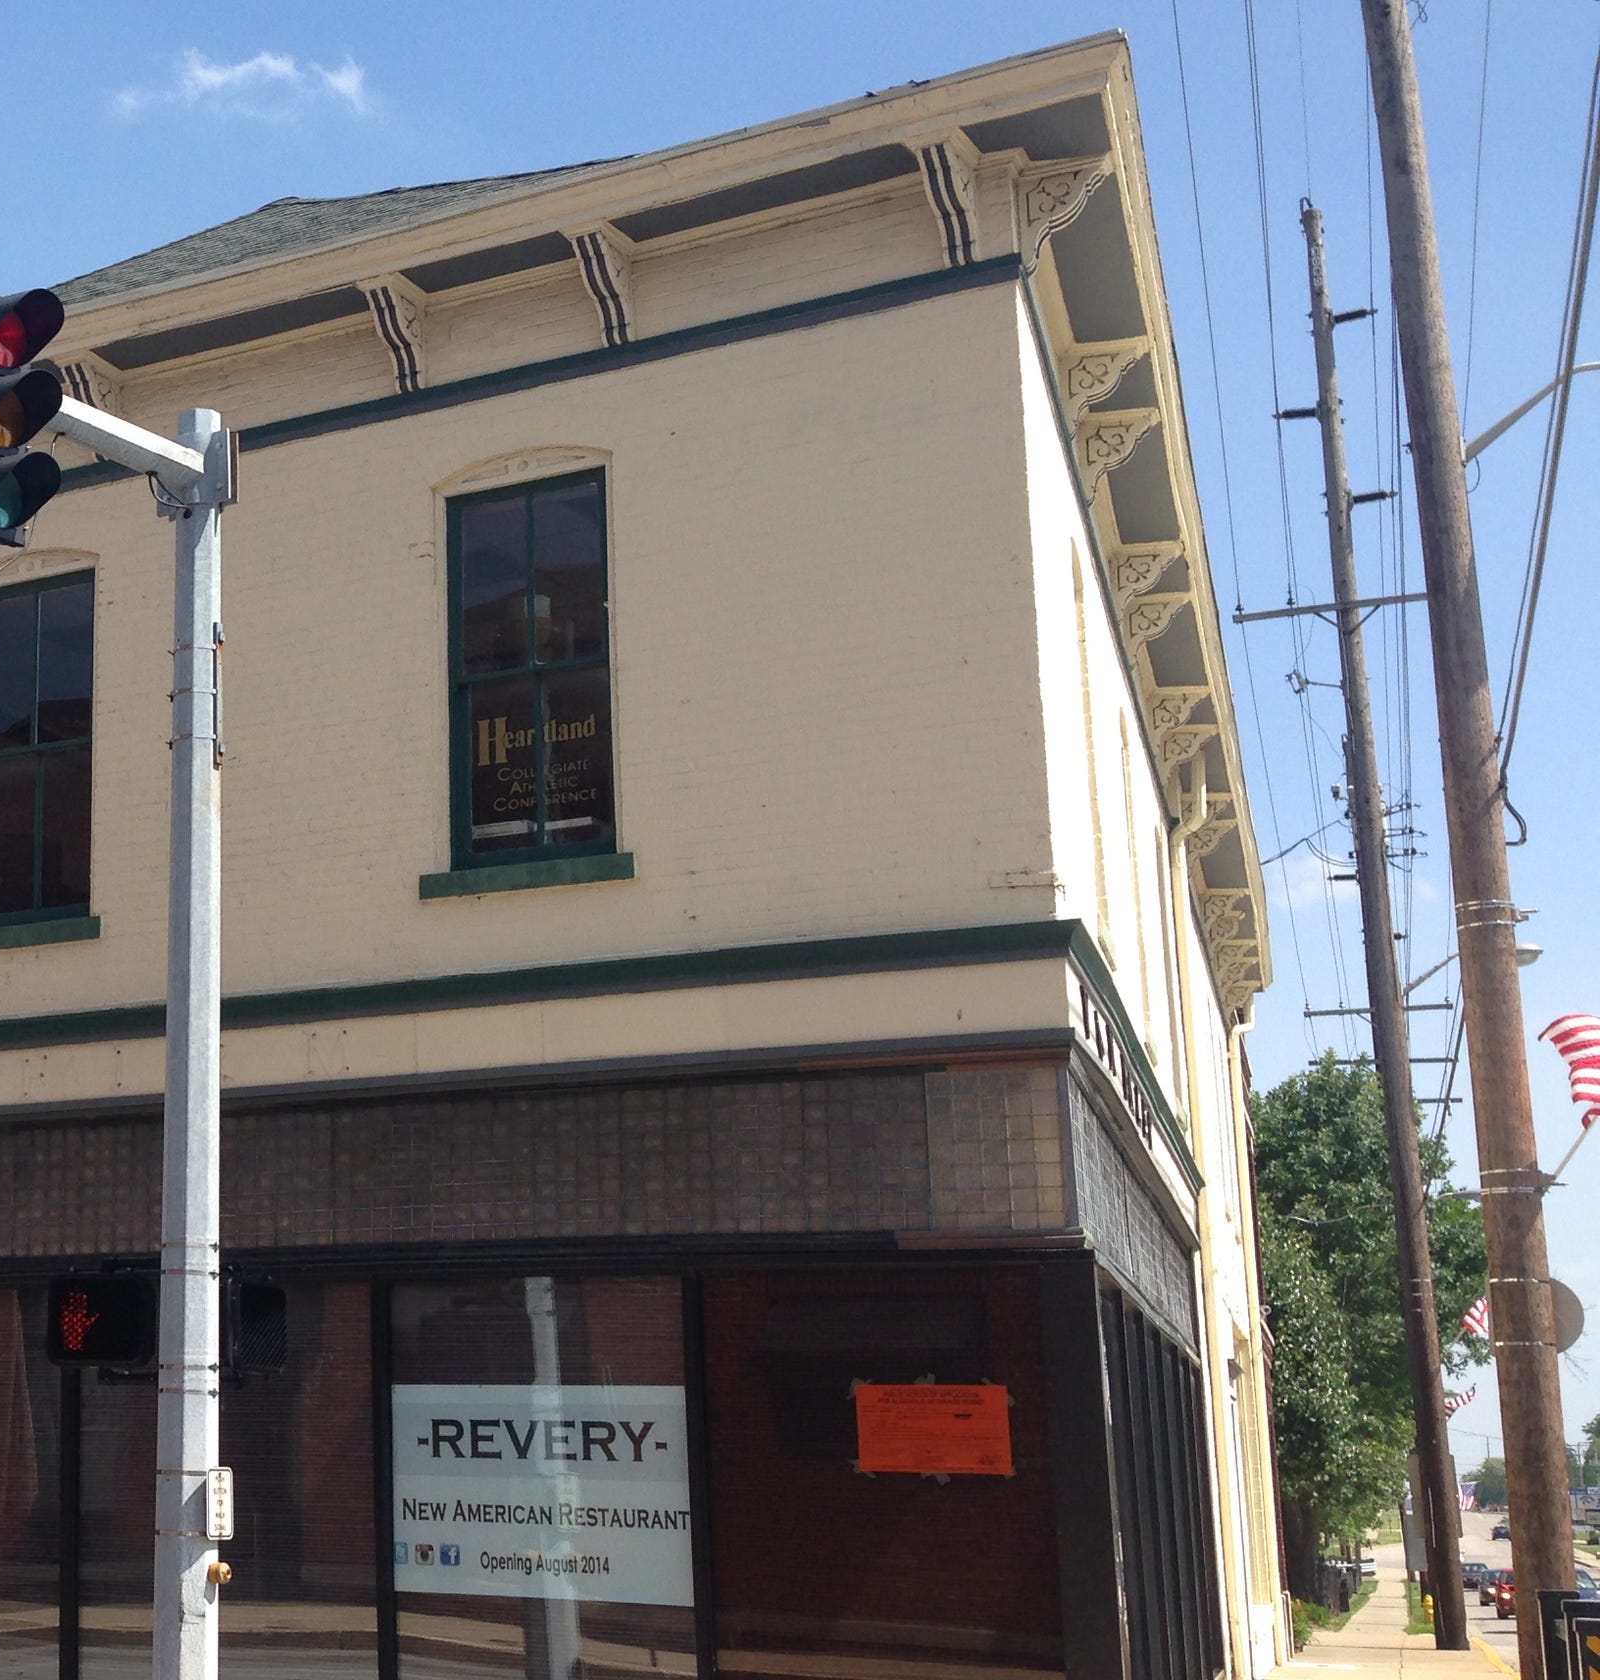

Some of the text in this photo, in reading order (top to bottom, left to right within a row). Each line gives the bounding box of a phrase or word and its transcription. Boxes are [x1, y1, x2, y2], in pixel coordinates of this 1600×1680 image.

[477, 713, 597, 767] Heartland
[402, 1498, 691, 1531] NEW AMERICAN RESTAURANT
[480, 1551, 610, 1577] Opening August 2014
